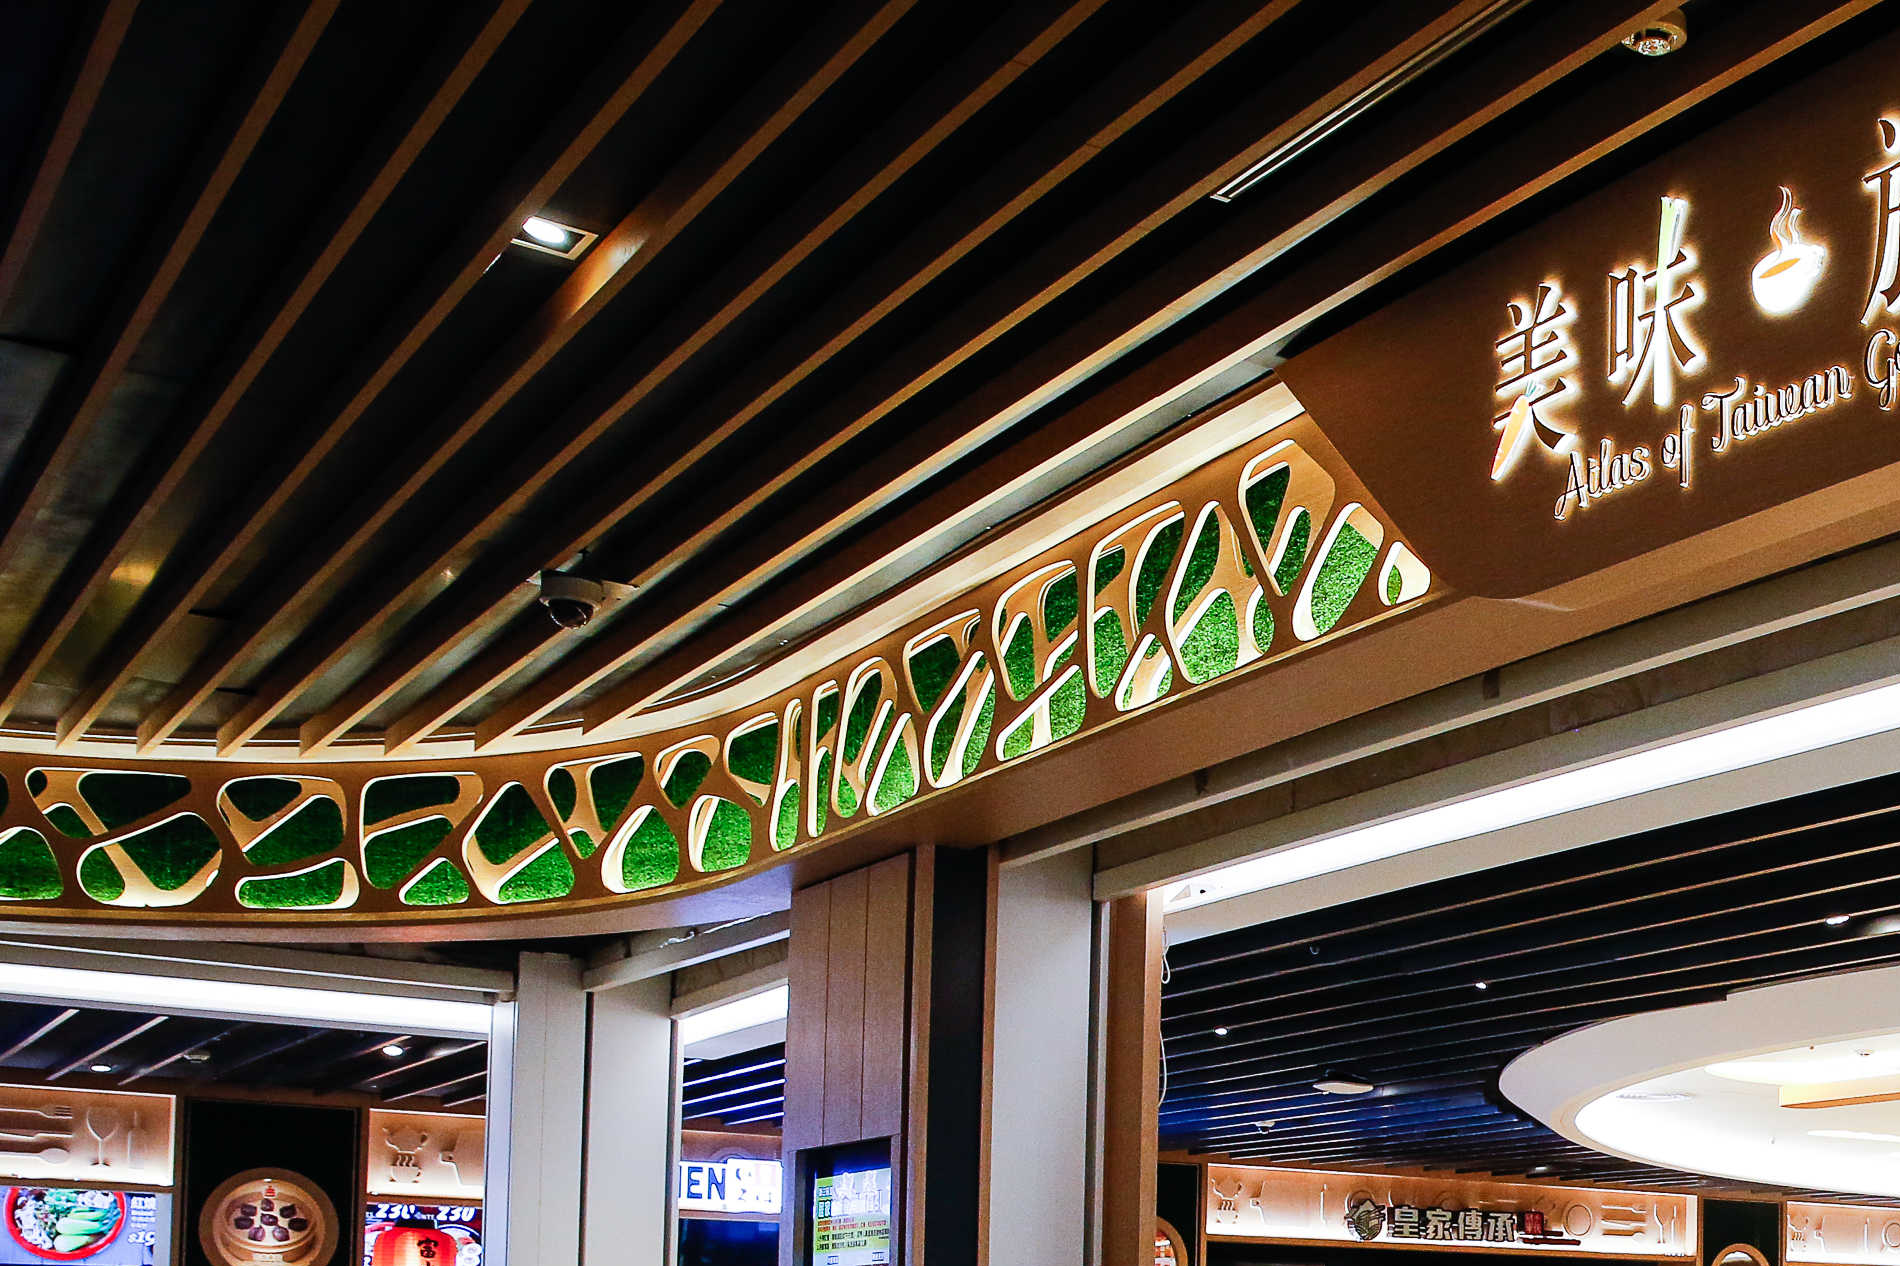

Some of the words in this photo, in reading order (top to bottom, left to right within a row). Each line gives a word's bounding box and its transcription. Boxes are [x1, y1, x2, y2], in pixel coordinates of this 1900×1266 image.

[1553, 437, 1651, 521] Atlas
[1660, 401, 1695, 488] of
[1701, 376, 1853, 455] Taiwan
[1393, 1205, 1516, 1242] 皇家傳承
